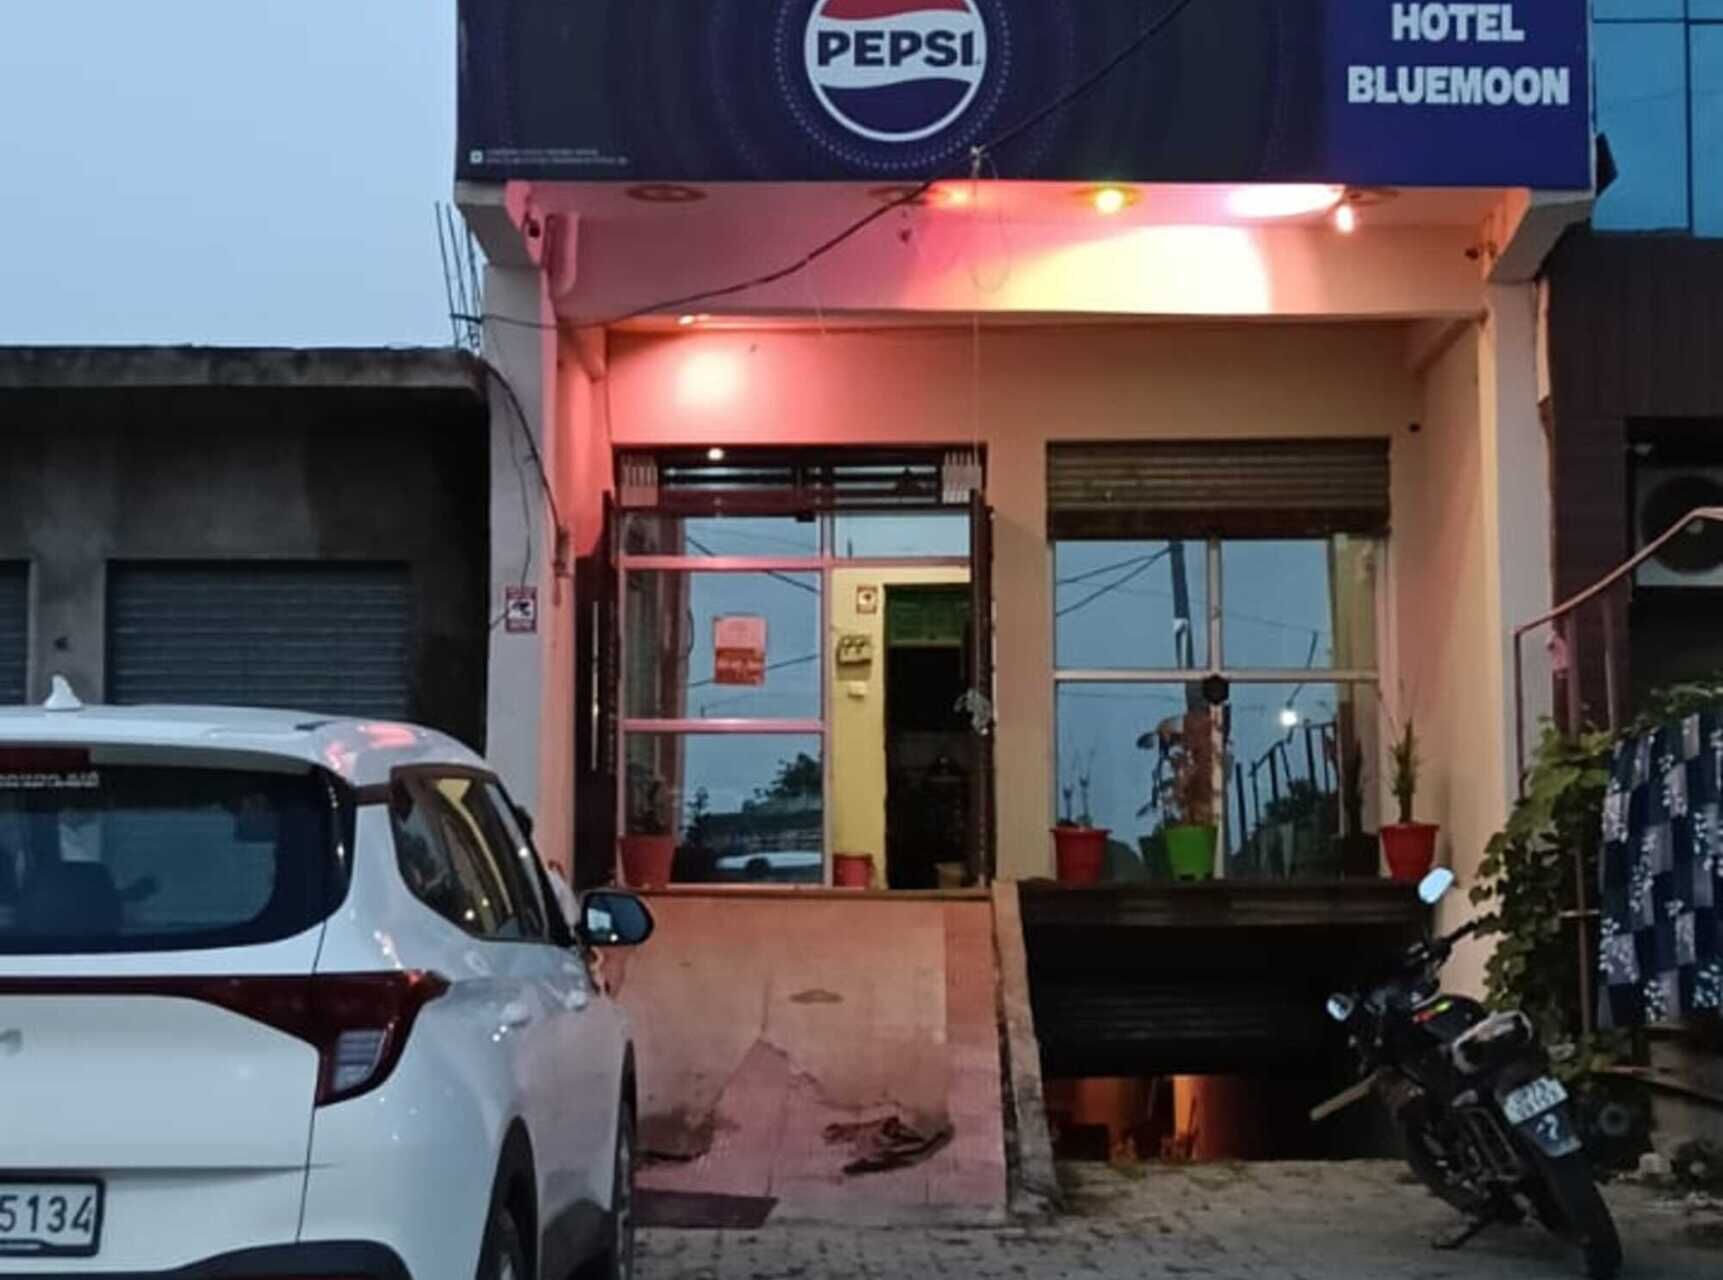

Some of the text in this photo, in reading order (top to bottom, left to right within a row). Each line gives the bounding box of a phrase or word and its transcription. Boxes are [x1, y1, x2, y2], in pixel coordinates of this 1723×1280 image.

[1392, 3, 1525, 41] HOTEL
[817, 30, 975, 67] PEPSI
[1348, 66, 1569, 104] BLUEMOON
[0, 1194, 92, 1233] 5134
